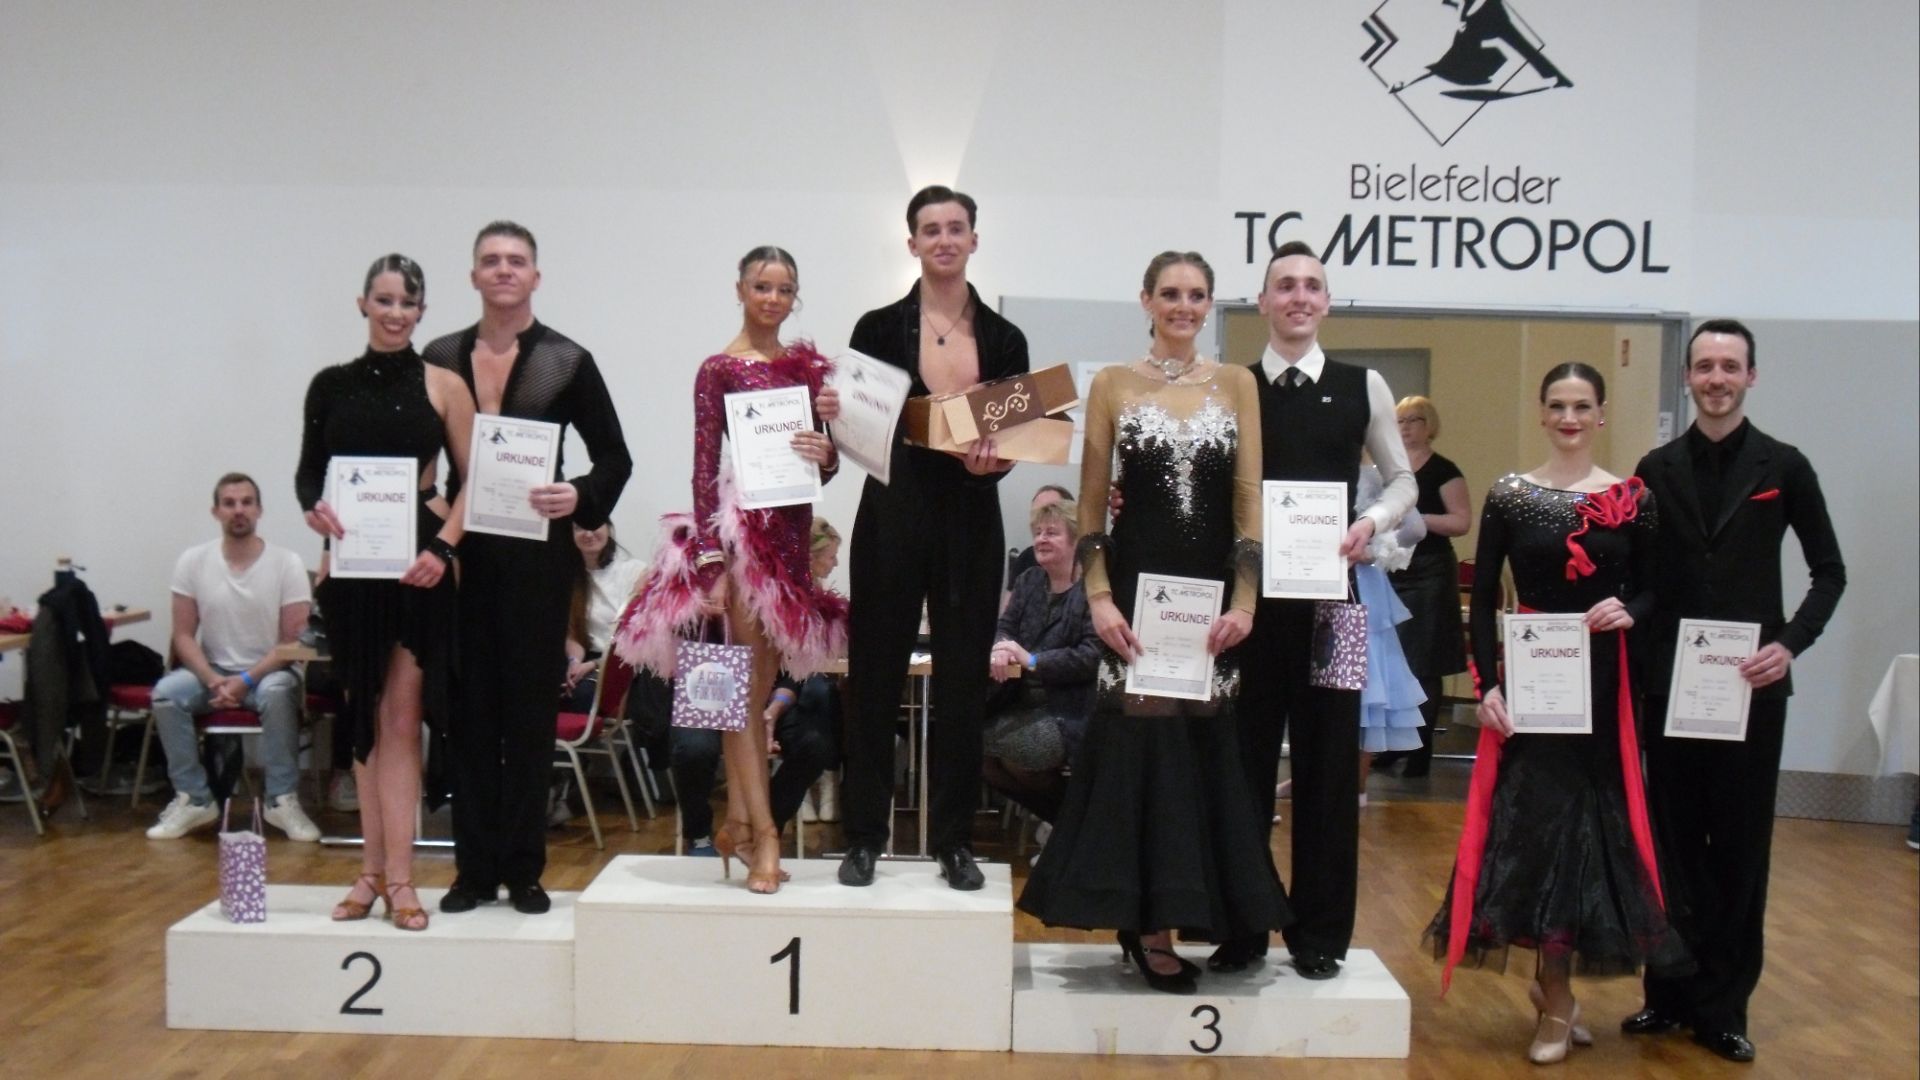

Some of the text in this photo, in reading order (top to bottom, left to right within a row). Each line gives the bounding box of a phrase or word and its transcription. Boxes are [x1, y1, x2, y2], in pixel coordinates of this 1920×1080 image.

[1350, 163, 1561, 204] Bielefelder
[1320, 213, 1671, 273] METROPOL
[754, 420, 804, 435] URKUNDE
[496, 451, 546, 467] URKUNDE
[356, 492, 406, 503] URKUNDE
[1289, 514, 1338, 526] URKUNDE
[1160, 610, 1211, 625] URKUNDE
[1530, 647, 1581, 658] URKUNDE
[339, 950, 383, 1015] 2
[770, 936, 801, 1014] 1
[1189, 1004, 1223, 1054] 3
